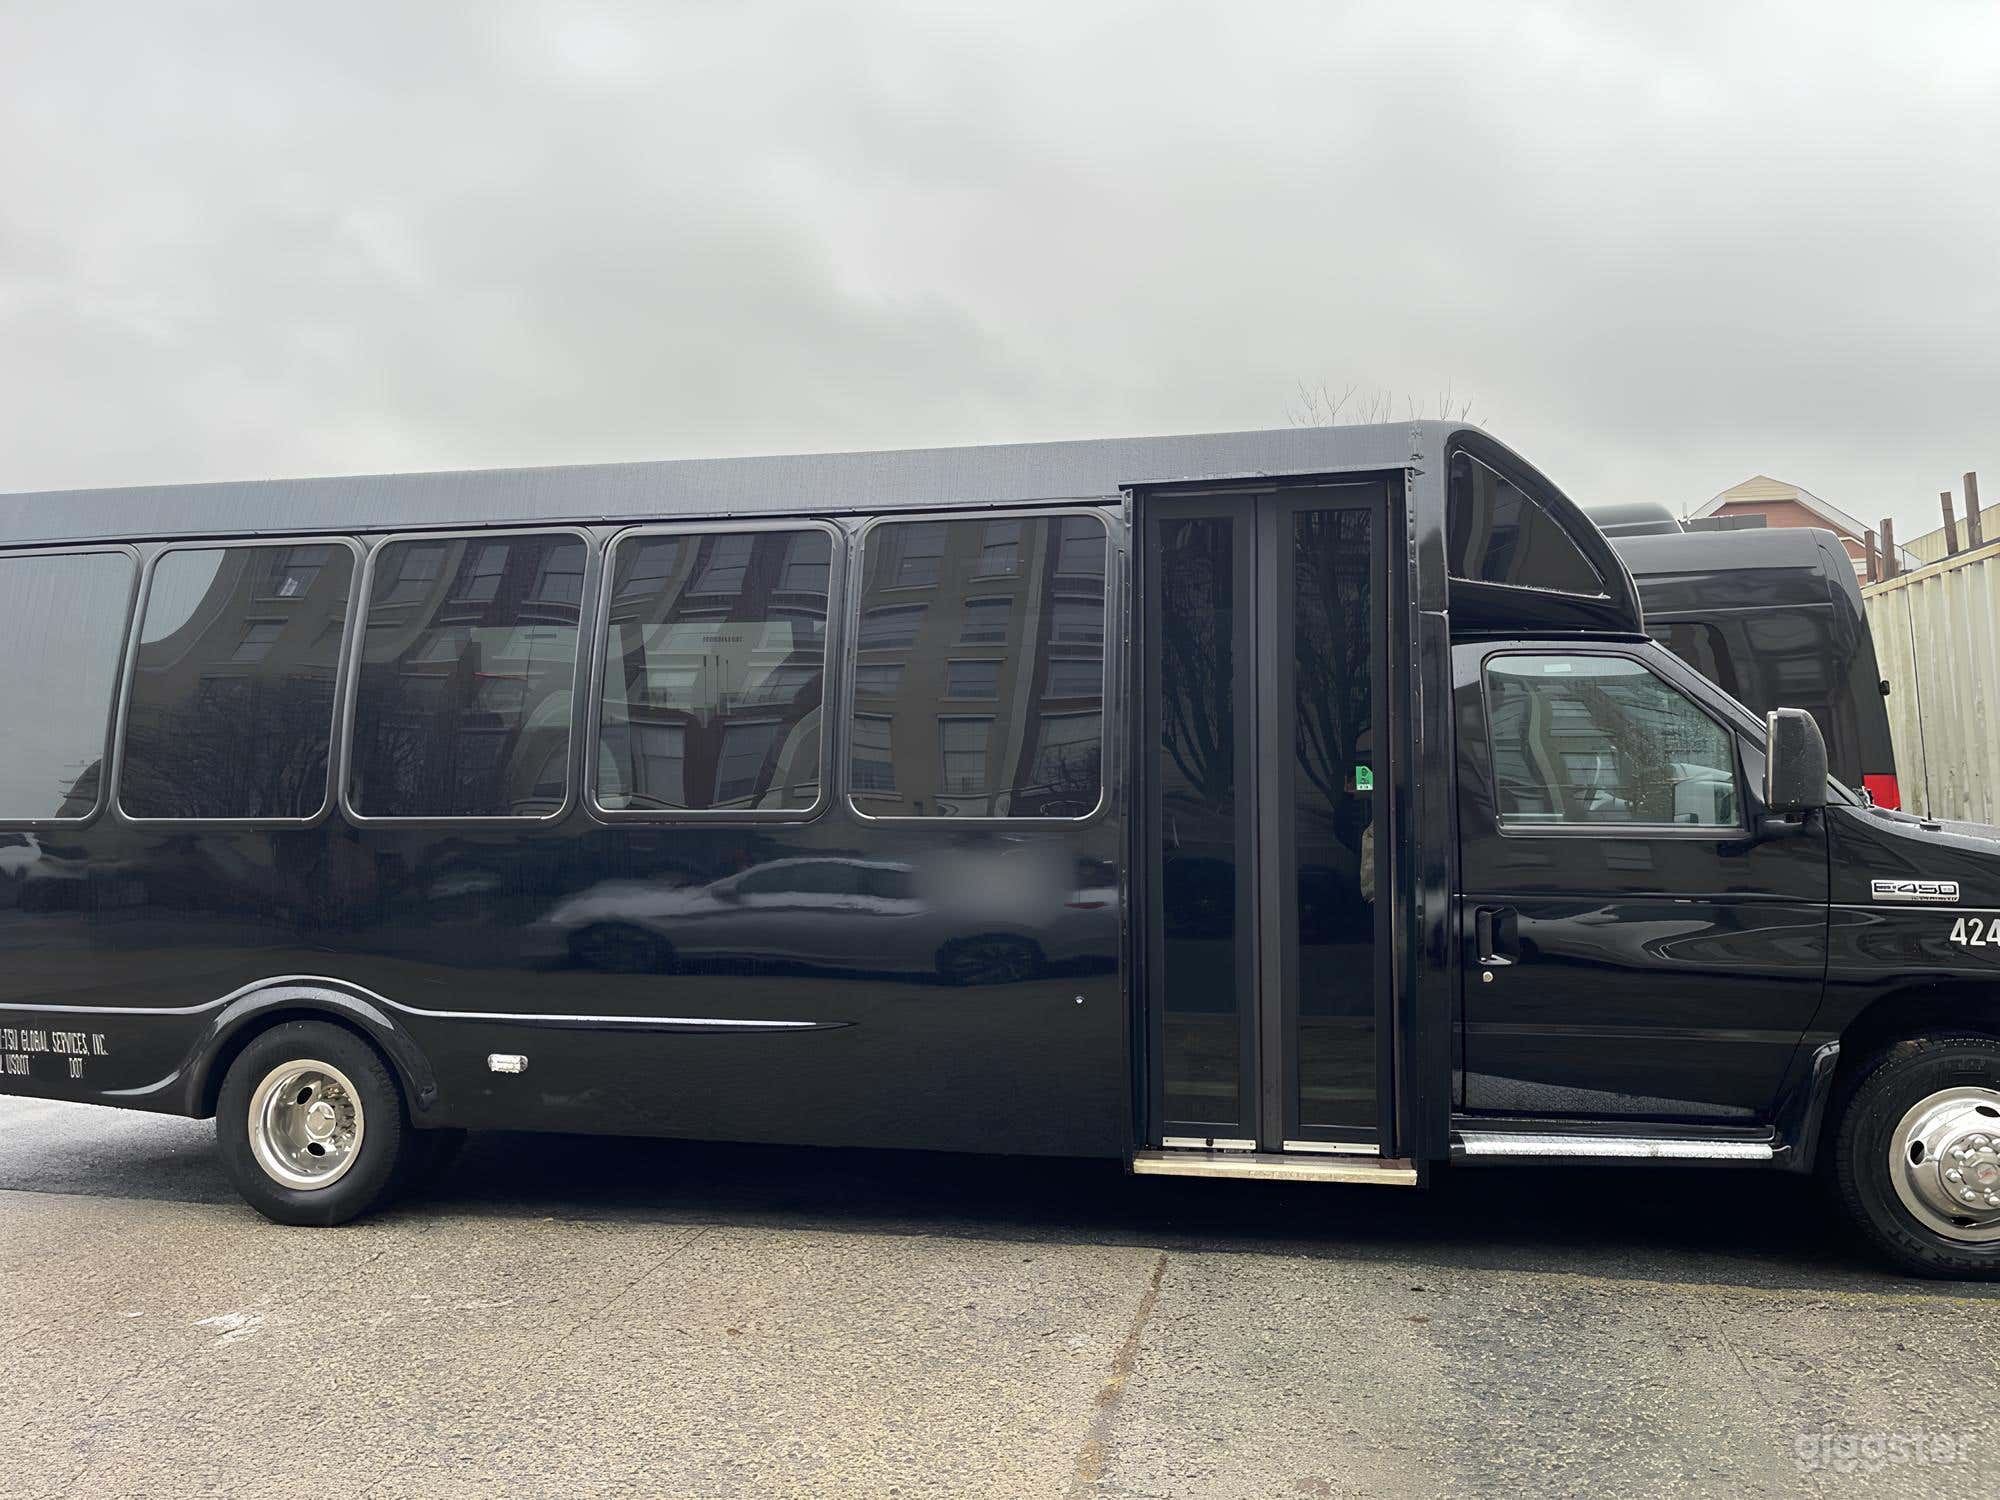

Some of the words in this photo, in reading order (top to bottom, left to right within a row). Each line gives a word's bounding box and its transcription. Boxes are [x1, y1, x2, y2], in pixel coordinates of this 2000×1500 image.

[1950, 917, 2000, 946] 424
[21, 1030, 50, 1051] GLOBAL
[52, 1032, 90, 1056] SERVICES,
